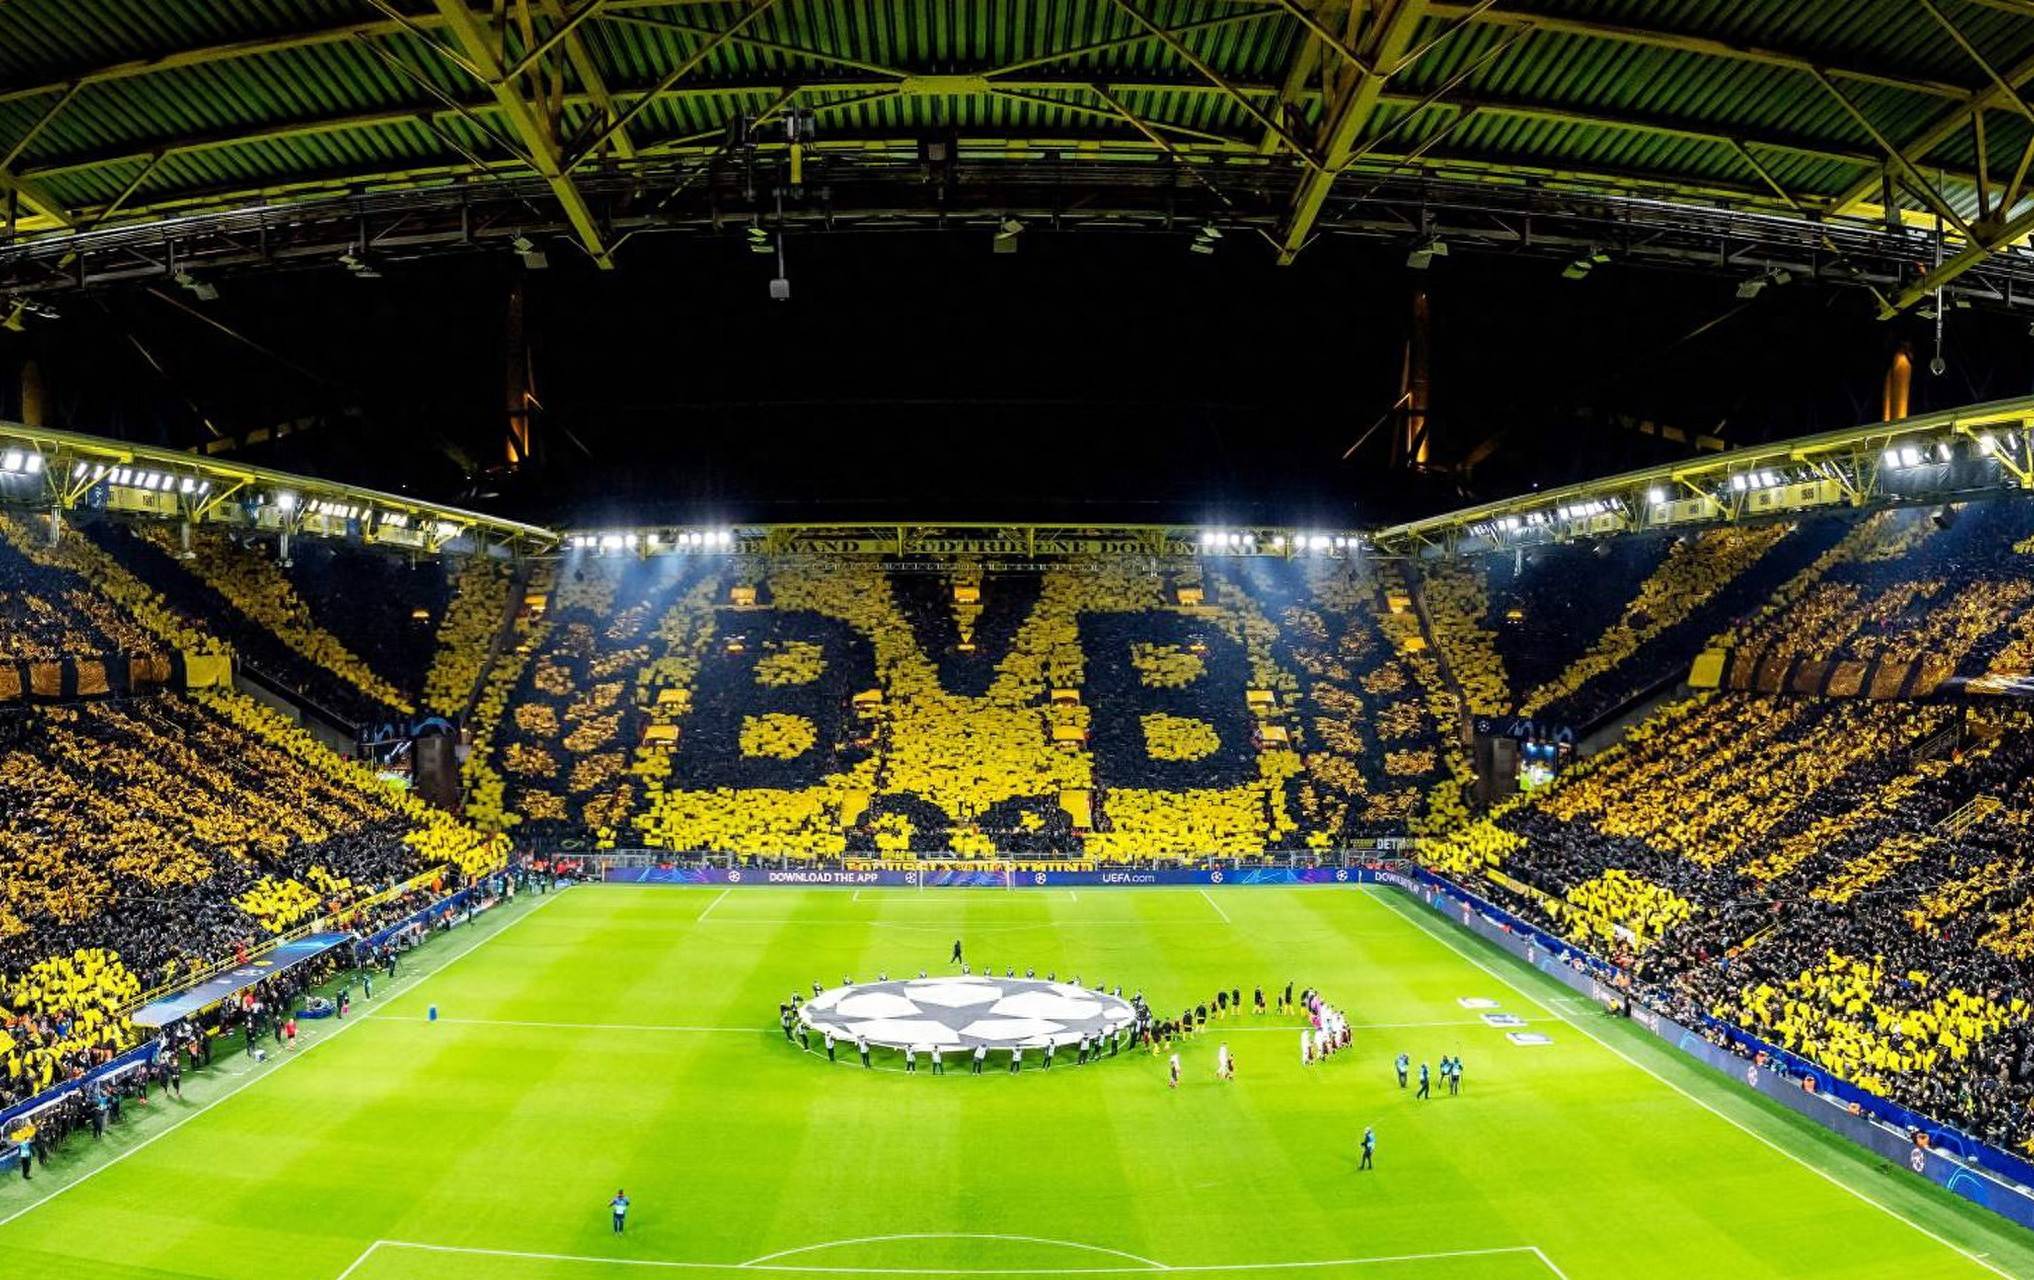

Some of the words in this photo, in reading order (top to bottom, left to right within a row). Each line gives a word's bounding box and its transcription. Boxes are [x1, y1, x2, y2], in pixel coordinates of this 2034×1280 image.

[675, 560, 1268, 790] BVB
[769, 873, 832, 883] DOWNLOAD
[834, 873, 854, 883] THE
[857, 873, 879, 883] APP
[1102, 873, 1155, 883] UEFA.com
